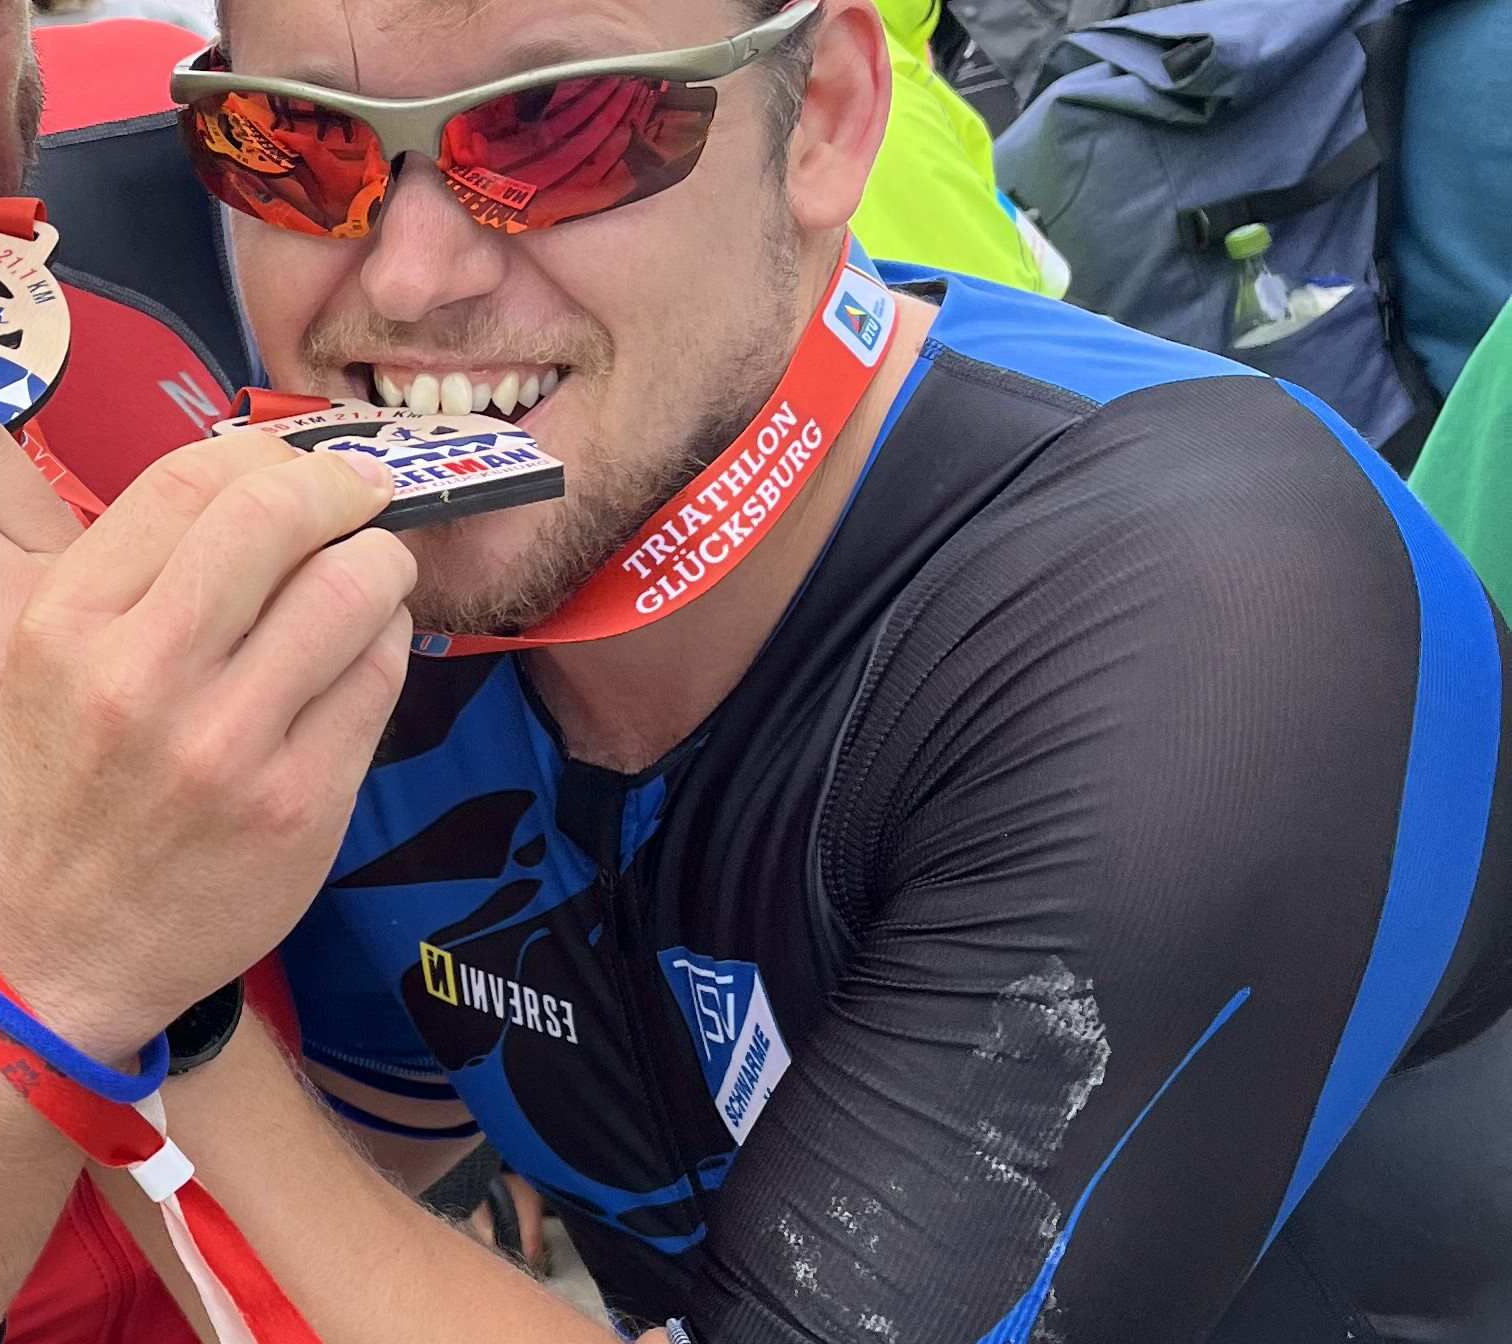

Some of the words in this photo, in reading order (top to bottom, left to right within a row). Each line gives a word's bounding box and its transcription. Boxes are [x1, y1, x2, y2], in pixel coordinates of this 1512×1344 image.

[26, 279, 57, 305] KM
[294, 414, 328, 427] KM
[622, 400, 798, 580] TRIATHLON
[635, 417, 823, 614] GLÜCKSBURG
[672, 958, 734, 1063] TSV
[724, 1022, 771, 1129] SCHWARME
